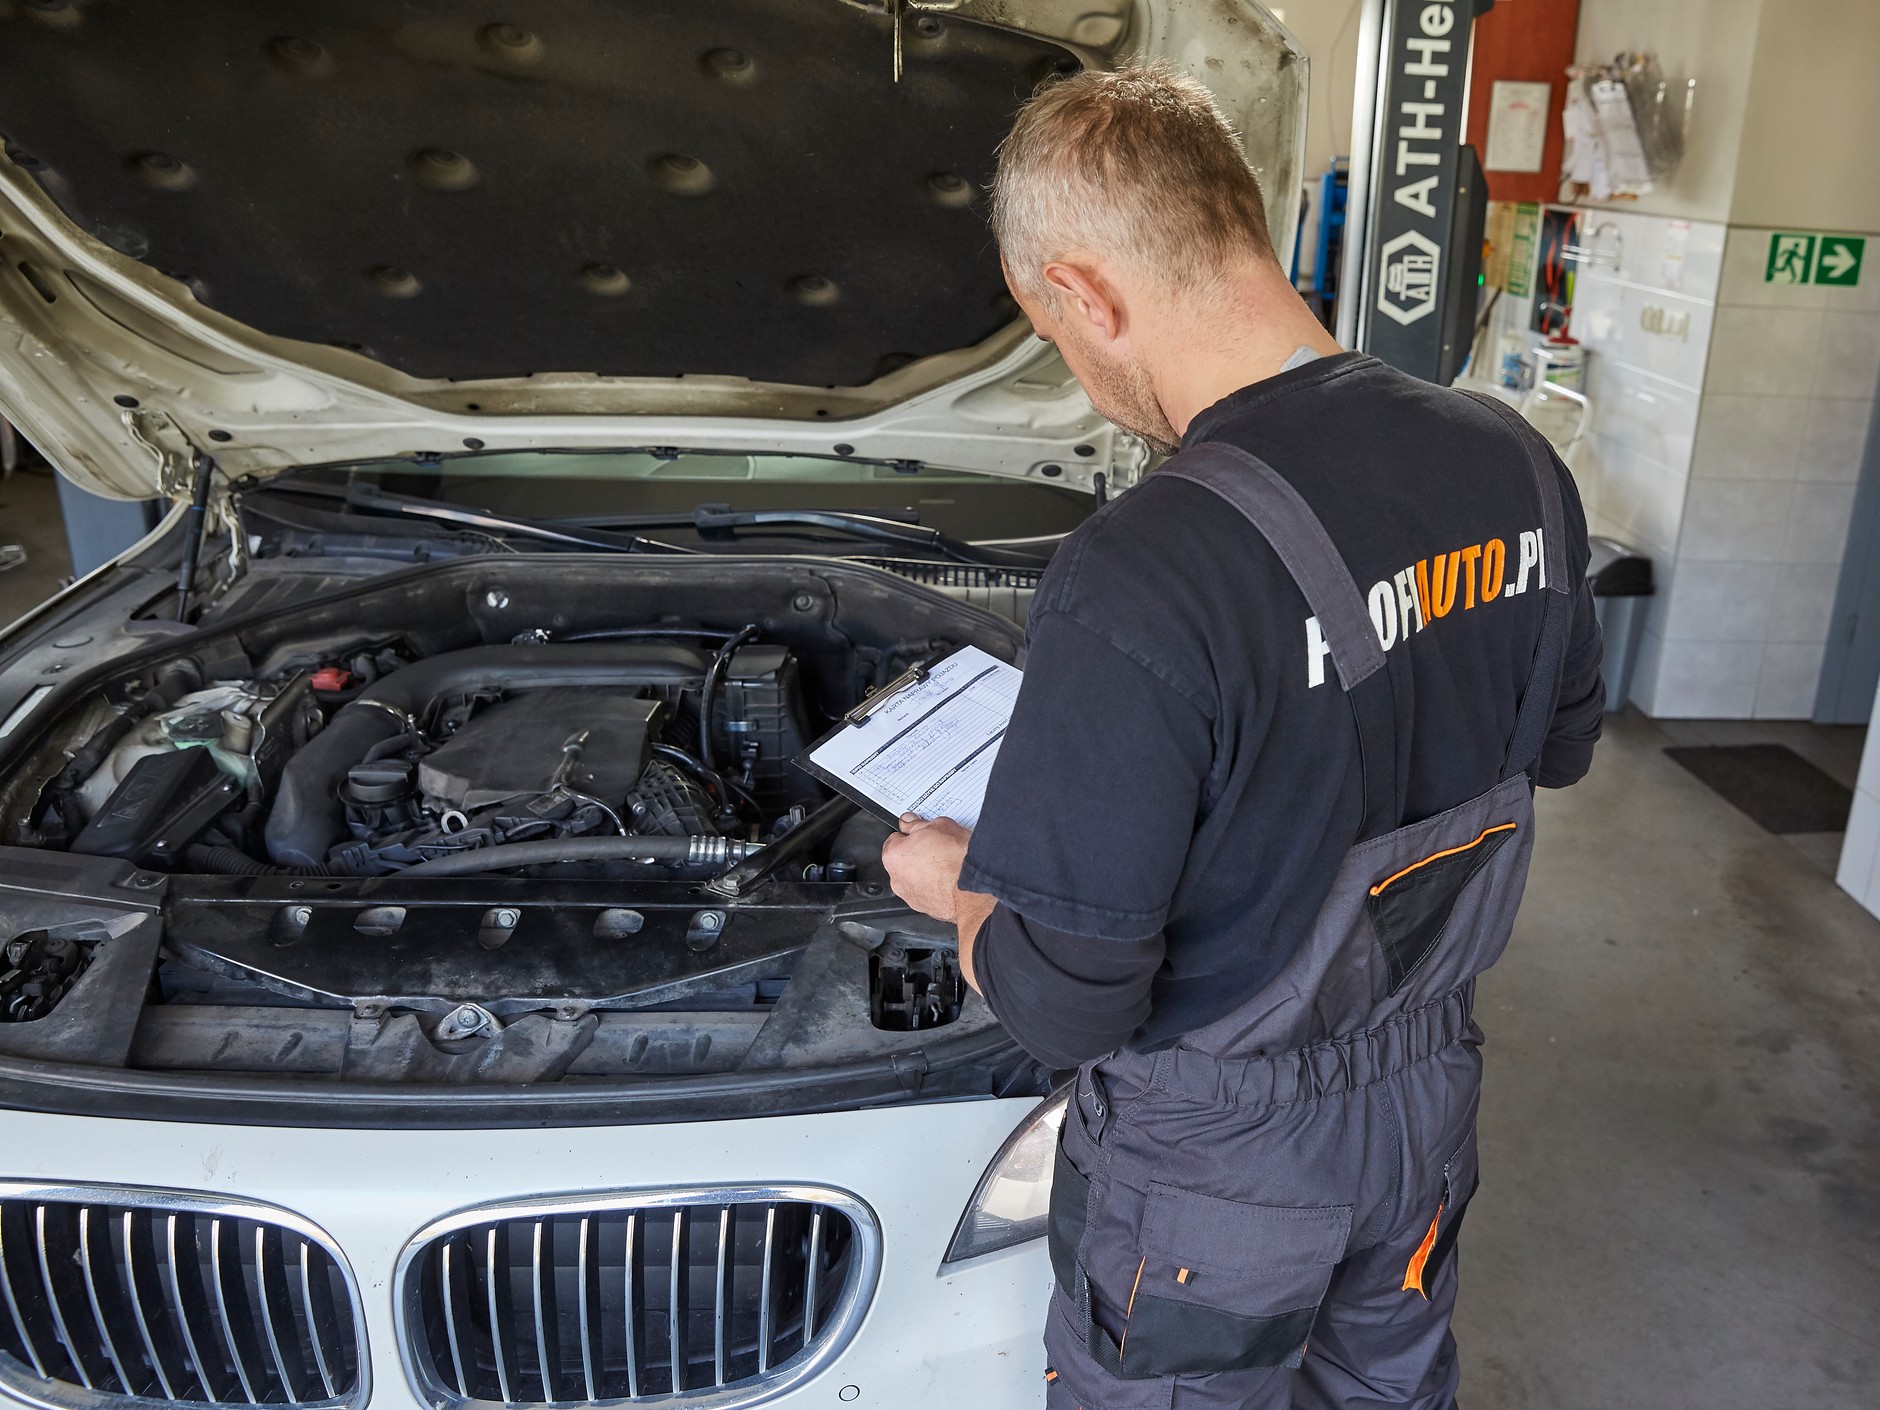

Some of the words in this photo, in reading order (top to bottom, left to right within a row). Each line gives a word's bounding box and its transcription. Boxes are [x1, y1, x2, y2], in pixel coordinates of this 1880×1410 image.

[1394, 0, 1455, 219] ATH-He
[1400, 254, 1432, 301] ATH
[1305, 528, 1546, 689] POFIAUTO.P
[884, 699, 905, 715] KARTA
[903, 680, 932, 702] NAPRAWY
[930, 661, 959, 682] POJAZDU
